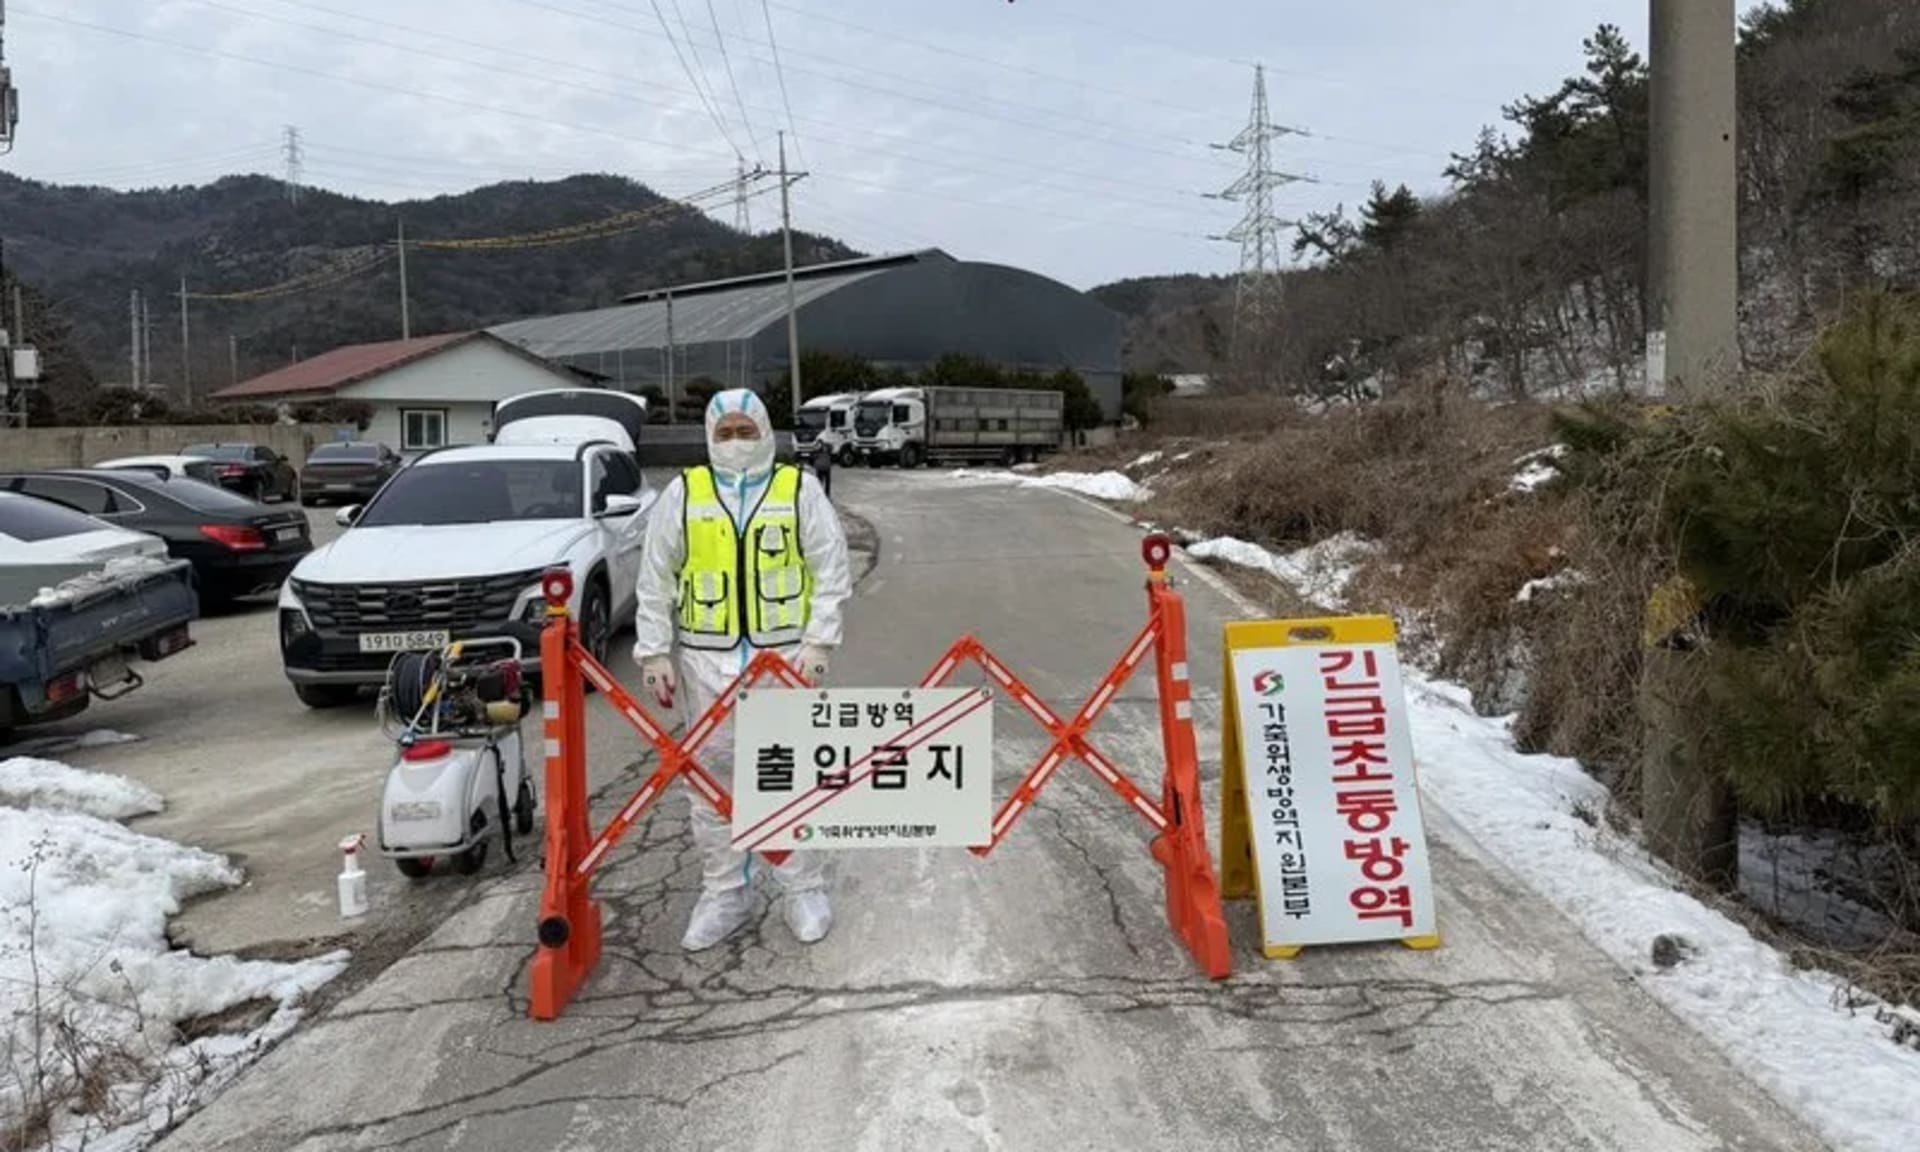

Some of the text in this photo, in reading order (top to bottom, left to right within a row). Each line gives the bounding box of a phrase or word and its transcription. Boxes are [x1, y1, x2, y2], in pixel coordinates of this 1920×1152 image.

[756, 744, 963, 792] 출입금지
[811, 702, 914, 728] 긴급방역
[1259, 703, 1311, 920] 가축위생방역지원본부
[1319, 650, 1413, 928] 긴급초동방역
